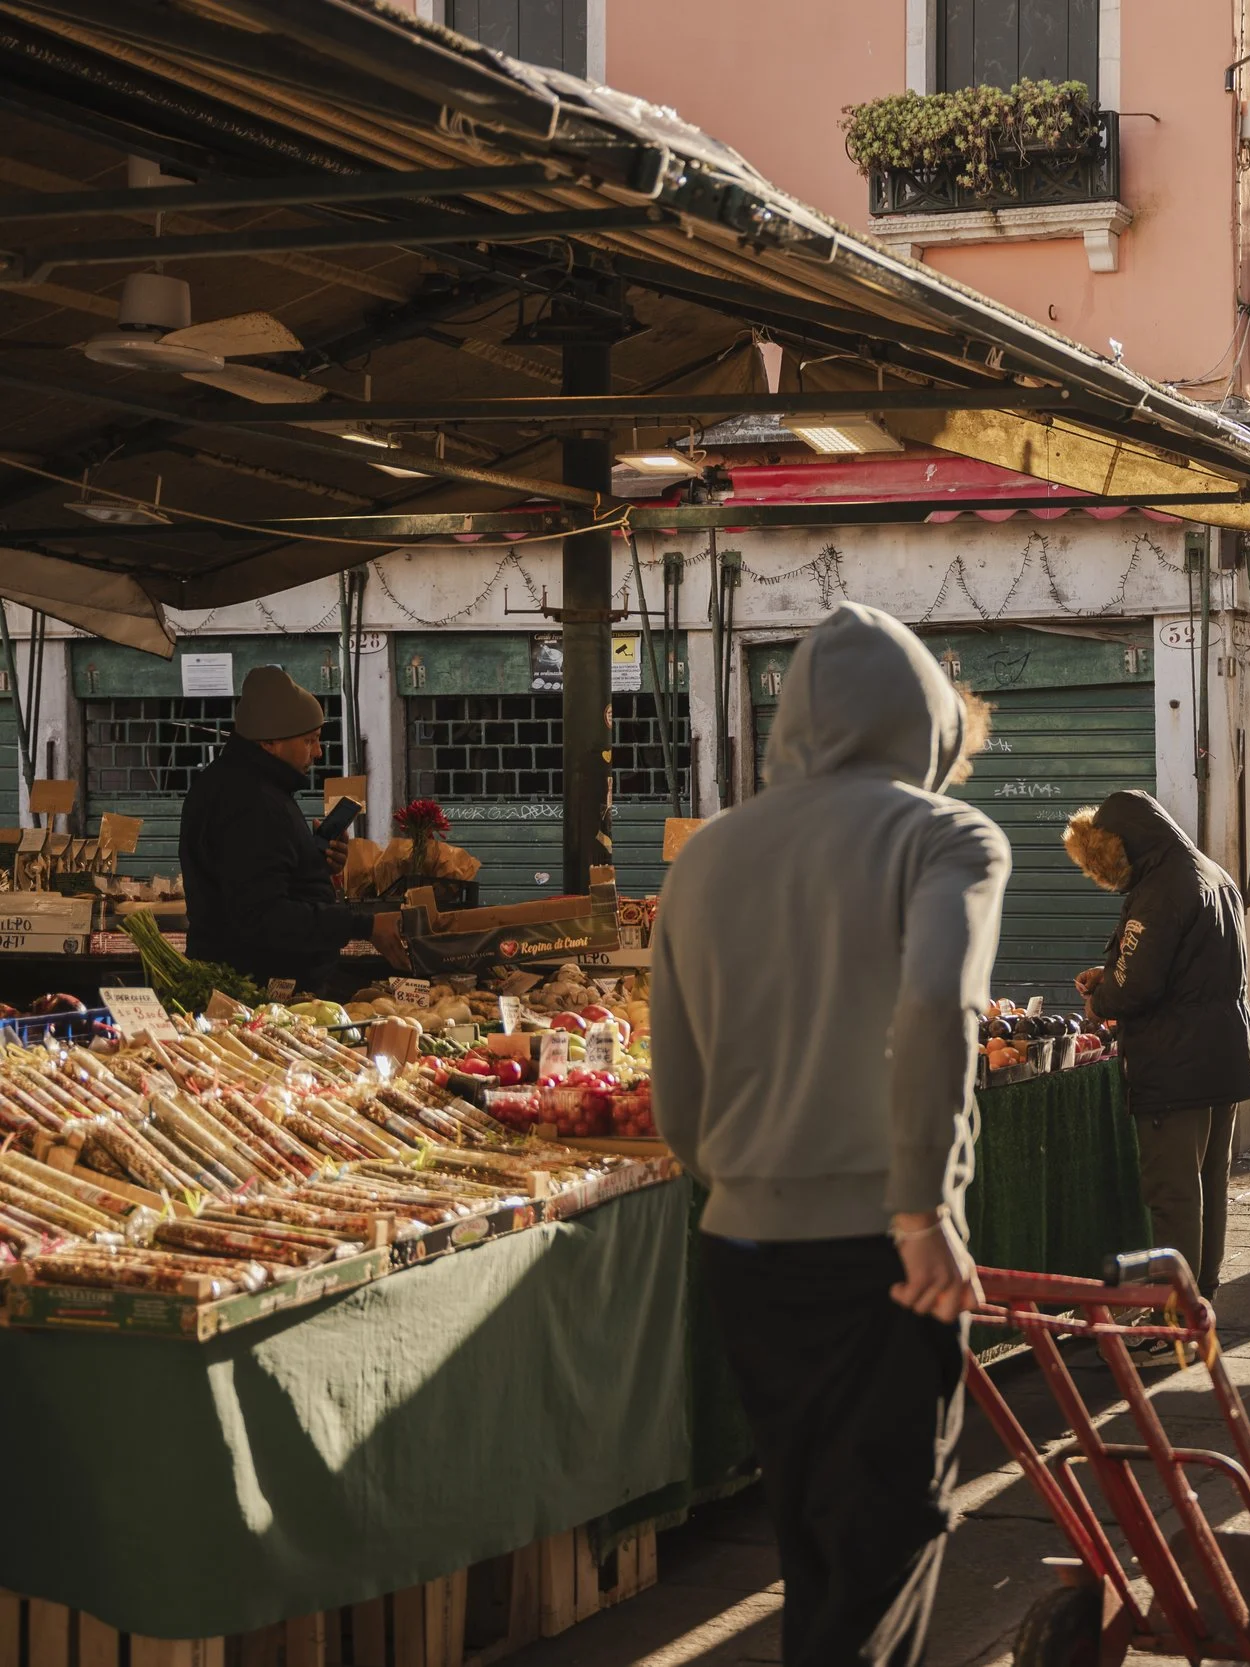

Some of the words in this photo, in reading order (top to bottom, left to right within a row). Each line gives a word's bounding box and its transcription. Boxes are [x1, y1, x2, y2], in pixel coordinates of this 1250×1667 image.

[521, 941, 553, 956] Regina
[554, 938, 564, 950] di
[564, 936, 589, 949] Cuori
